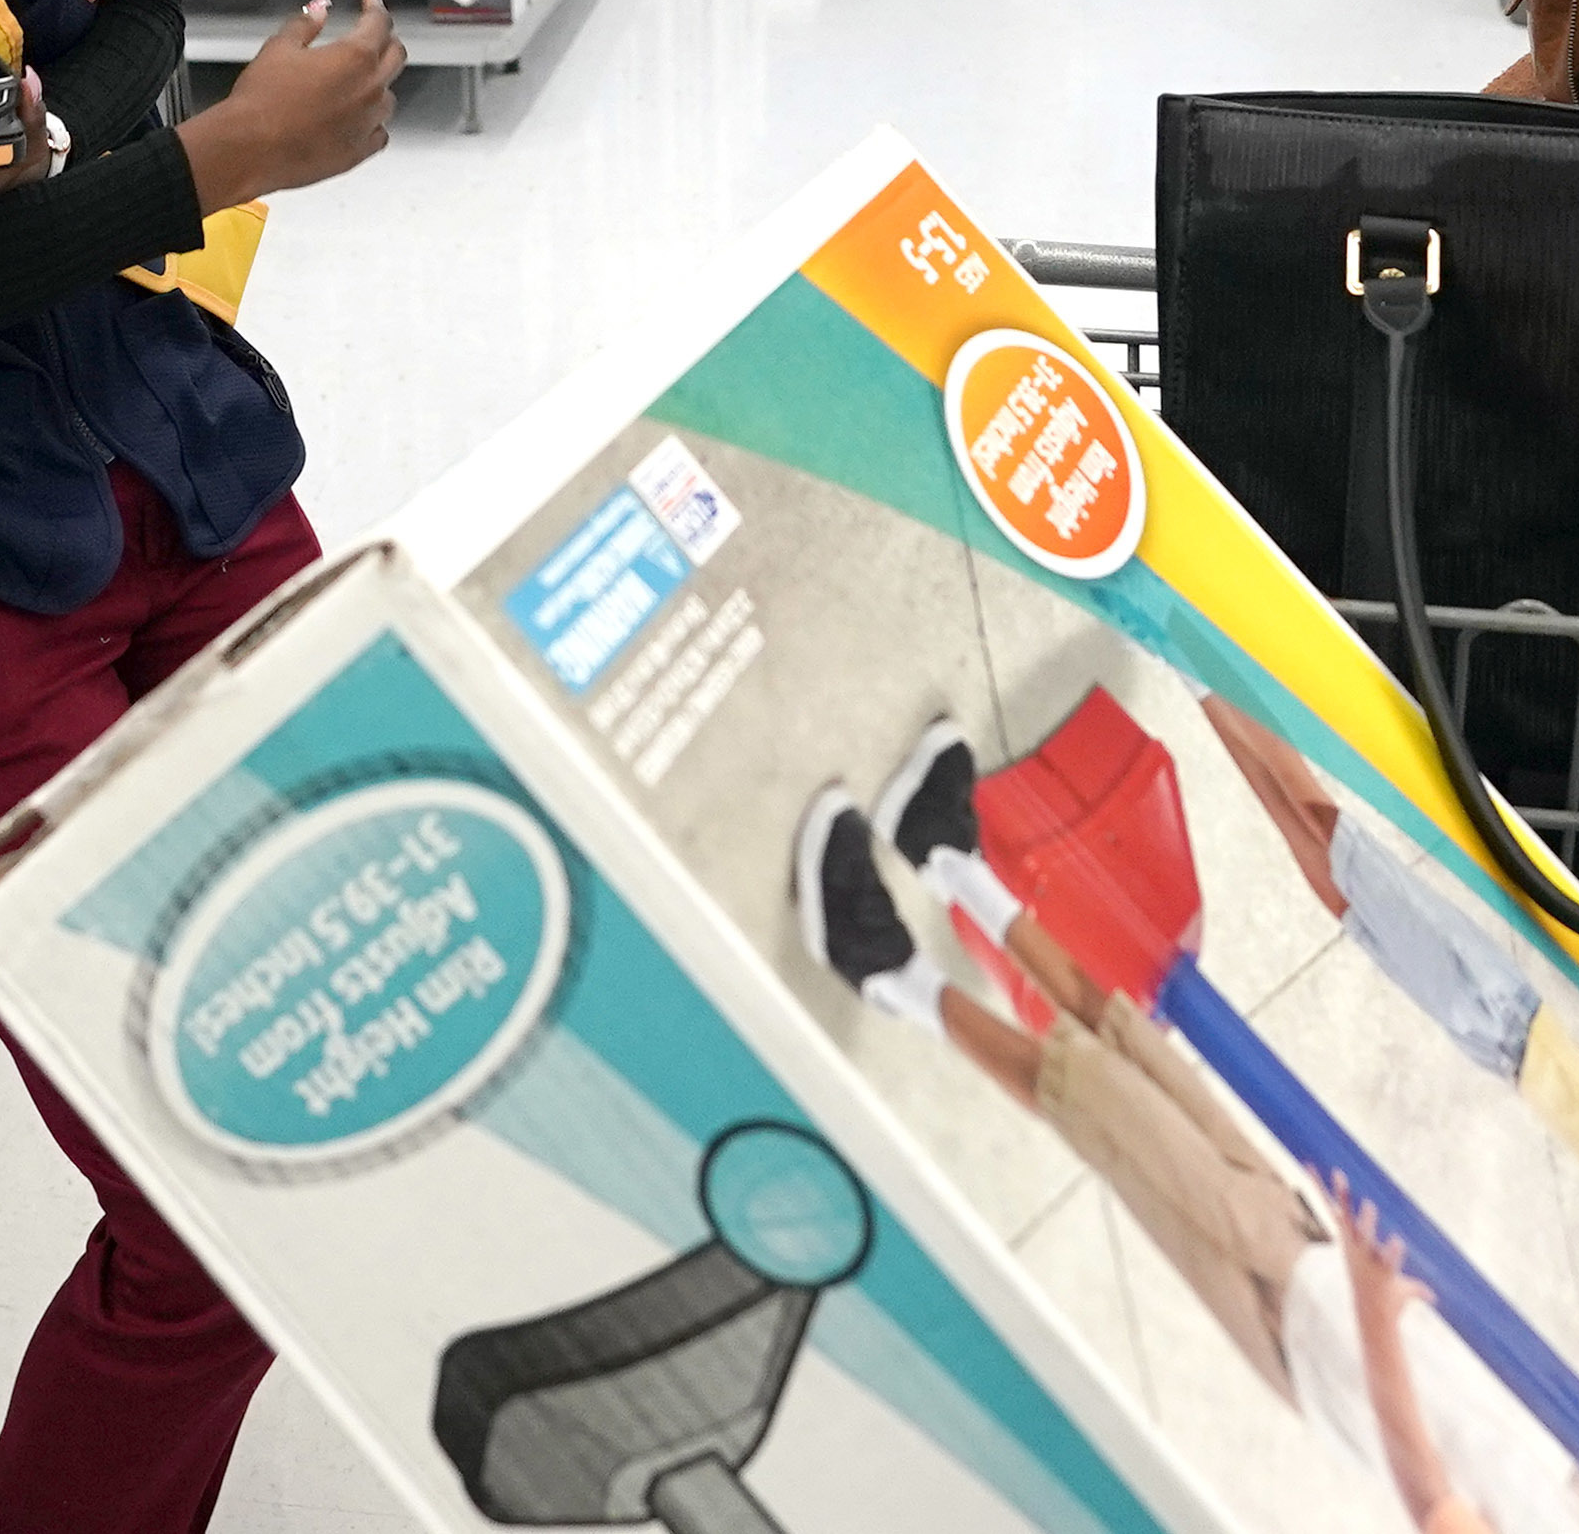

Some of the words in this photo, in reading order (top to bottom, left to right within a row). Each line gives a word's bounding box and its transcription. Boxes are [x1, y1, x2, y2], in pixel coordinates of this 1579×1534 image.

[308, 812, 462, 952] 31-39.5
[329, 871, 479, 1006] Adjusts
[183, 926, 324, 1058] inches!
[237, 987, 346, 1079] from
[414, 934, 508, 1016] Rim
[292, 994, 433, 1117] Height
